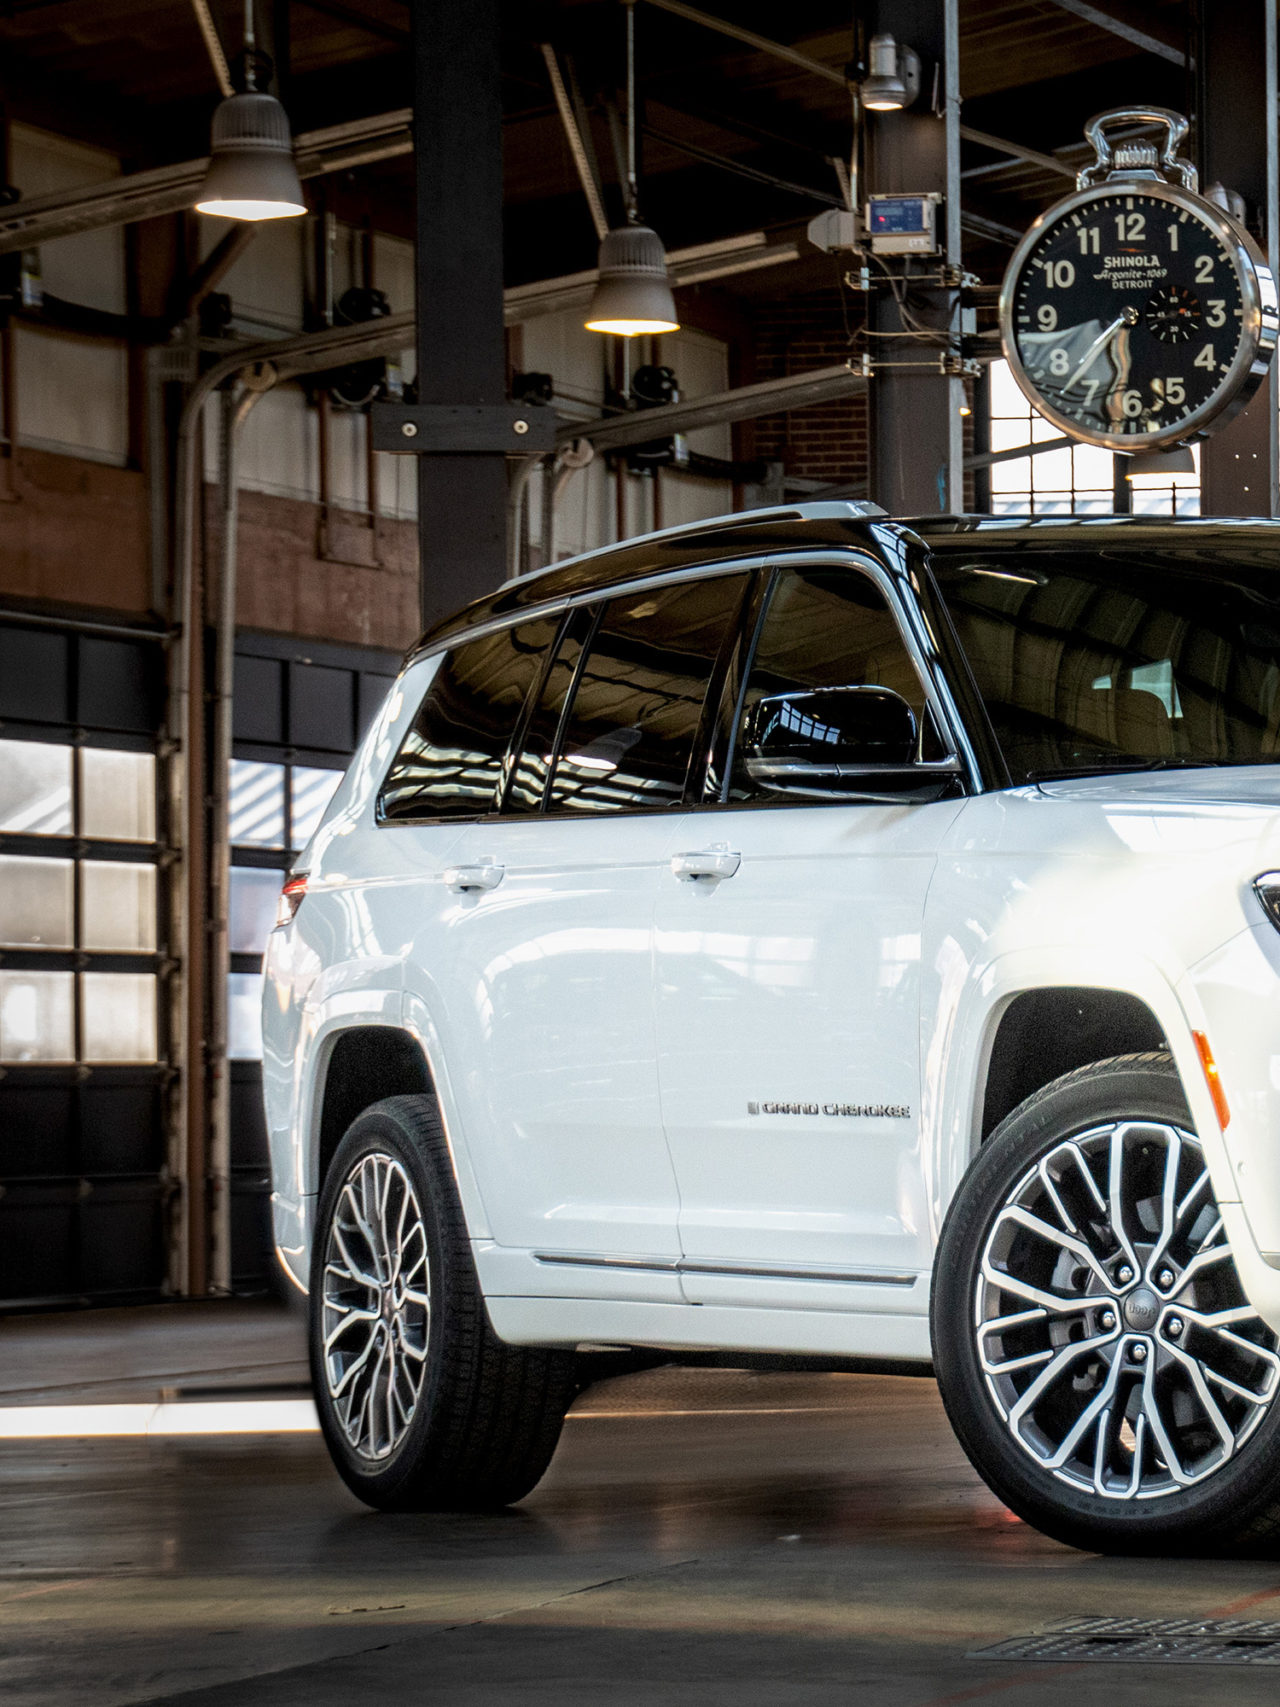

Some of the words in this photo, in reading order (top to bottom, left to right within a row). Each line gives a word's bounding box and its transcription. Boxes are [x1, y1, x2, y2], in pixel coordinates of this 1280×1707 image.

[1077, 227, 1100, 254] 11
[1114, 213, 1146, 241] 12
[1167, 225, 1179, 251] 1
[1043, 260, 1075, 288] 10
[1103, 255, 1160, 268] SHINOLA
[1195, 256, 1214, 283] 2
[1111, 280, 1153, 289] DETROIT
[1037, 304, 1058, 332] 9
[1206, 300, 1226, 327] 3
[1050, 349, 1070, 376] 8
[1194, 344, 1216, 371] 4
[1080, 379, 1100, 406] 7
[1122, 390, 1143, 417] 6
[1165, 377, 1185, 404] 5
[762, 1102, 819, 1115] GRAND
[822, 1103, 911, 1118] CHEROKEE
